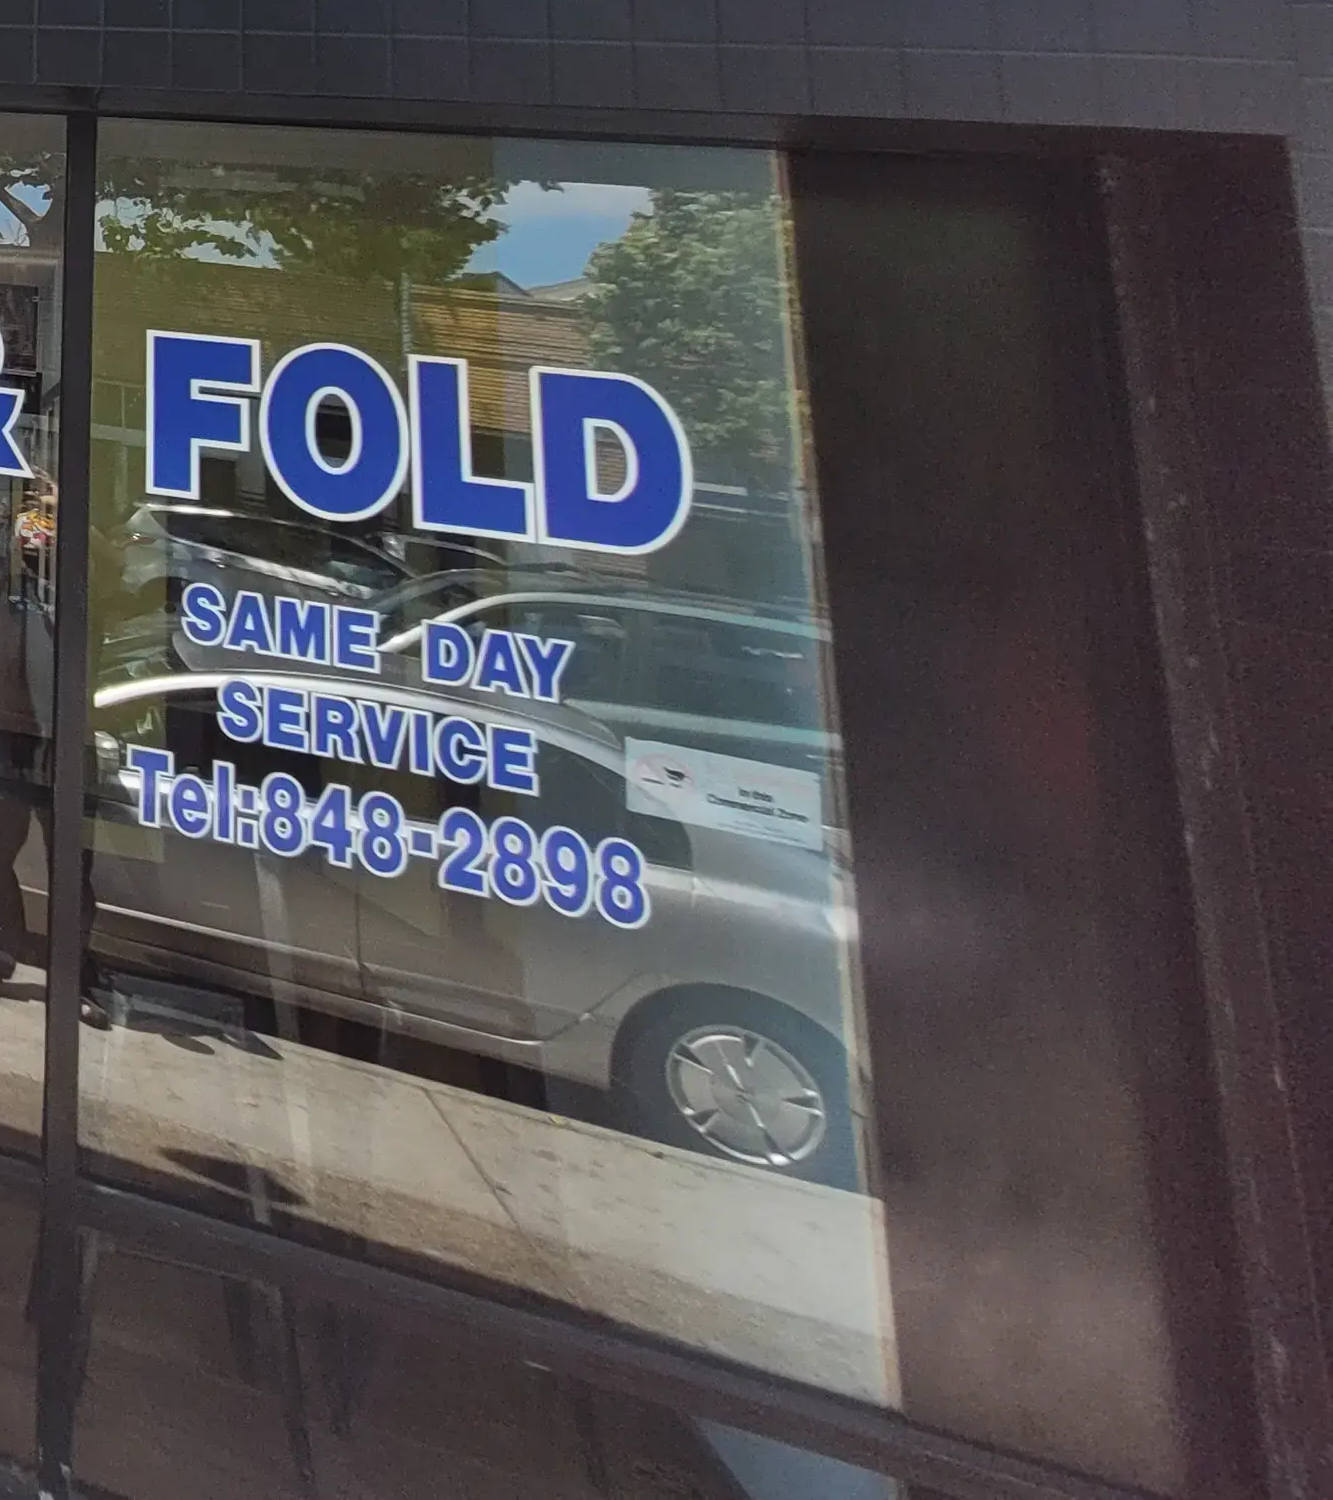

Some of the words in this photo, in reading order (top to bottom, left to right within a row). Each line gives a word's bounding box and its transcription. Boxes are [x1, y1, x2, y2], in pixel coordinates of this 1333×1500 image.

[144, 328, 695, 557] FOLD
[180, 582, 381, 675] SAME
[421, 621, 576, 704] DAY
[216, 680, 541, 799] SERVICE
[124, 742, 654, 930] Tel:848-2898
